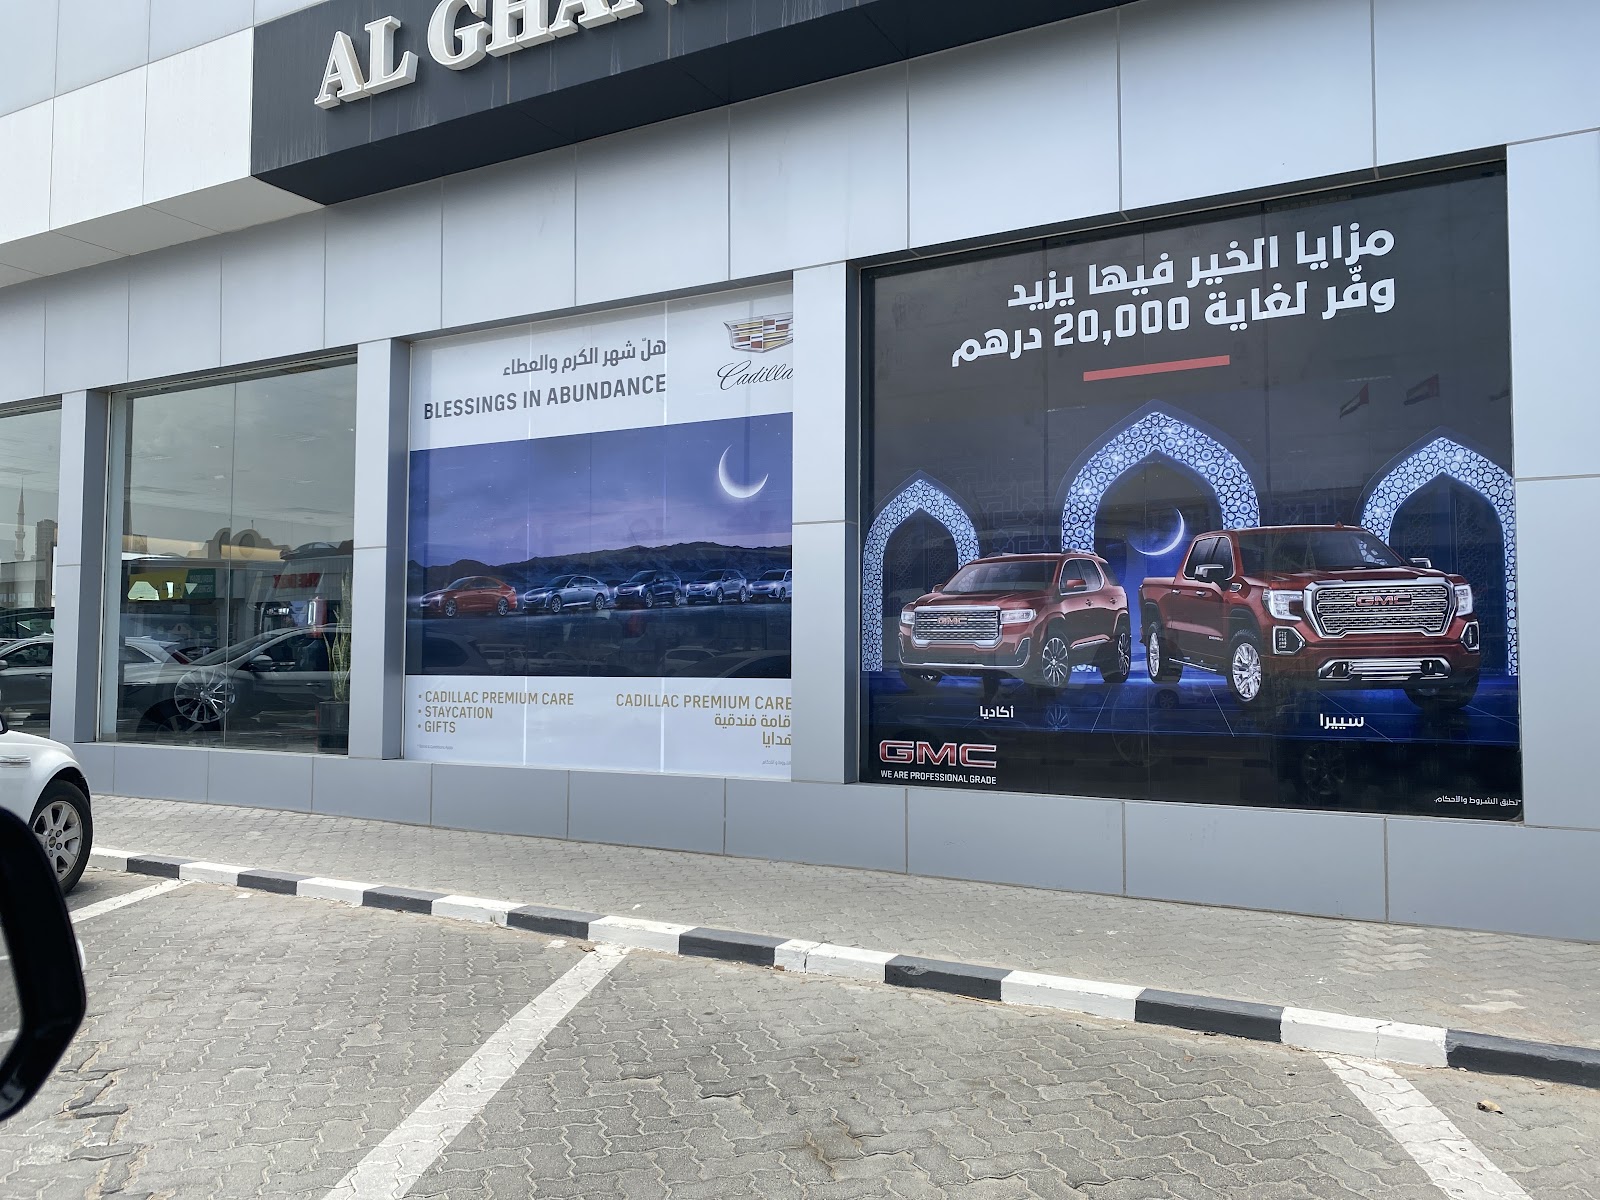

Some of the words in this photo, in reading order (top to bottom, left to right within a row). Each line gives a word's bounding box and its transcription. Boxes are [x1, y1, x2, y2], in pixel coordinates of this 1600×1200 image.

[314, 15, 418, 110] AL
[1296, 222, 1395, 271] مزايا
[1187, 235, 1279, 287] الخير
[1089, 253, 1173, 296] فيها
[1008, 270, 1073, 311] يزيد
[1204, 281, 1308, 331] لغاية
[1054, 296, 1190, 346] 20,000
[602, 340, 636, 367] شهر
[952, 324, 1042, 368] درهم
[503, 354, 558, 376] والعطاء
[562, 347, 598, 373] الكرم
[717, 360, 793, 390] Cadilla
[424, 392, 517, 420] BLESSINGS
[523, 389, 541, 408] IN
[546, 373, 666, 406] ABUNDANCE
[1356, 594, 1411, 606] GMC
[425, 690, 479, 704] CADILLAC
[482, 691, 538, 705] PREMIUM
[541, 692, 574, 706] CARE
[616, 693, 680, 708] CADILLAC
[683, 694, 750, 709] PREMIUM
[754, 695, 792, 710] CARE
[425, 705, 493, 719] STAYCATION
[714, 713, 757, 729] فندقية
[761, 713, 791, 728] قامة
[979, 705, 1014, 720] أكاديا
[1319, 713, 1364, 730] سييرا
[425, 720, 456, 733] GIFTS
[879, 740, 997, 768] GMC
[880, 769, 893, 779] WE
[893, 771, 909, 780] ARE
[910, 771, 968, 783] PROFESSIONAL
[969, 774, 997, 785] GRADE
[1469, 796, 1498, 806] الشروط
